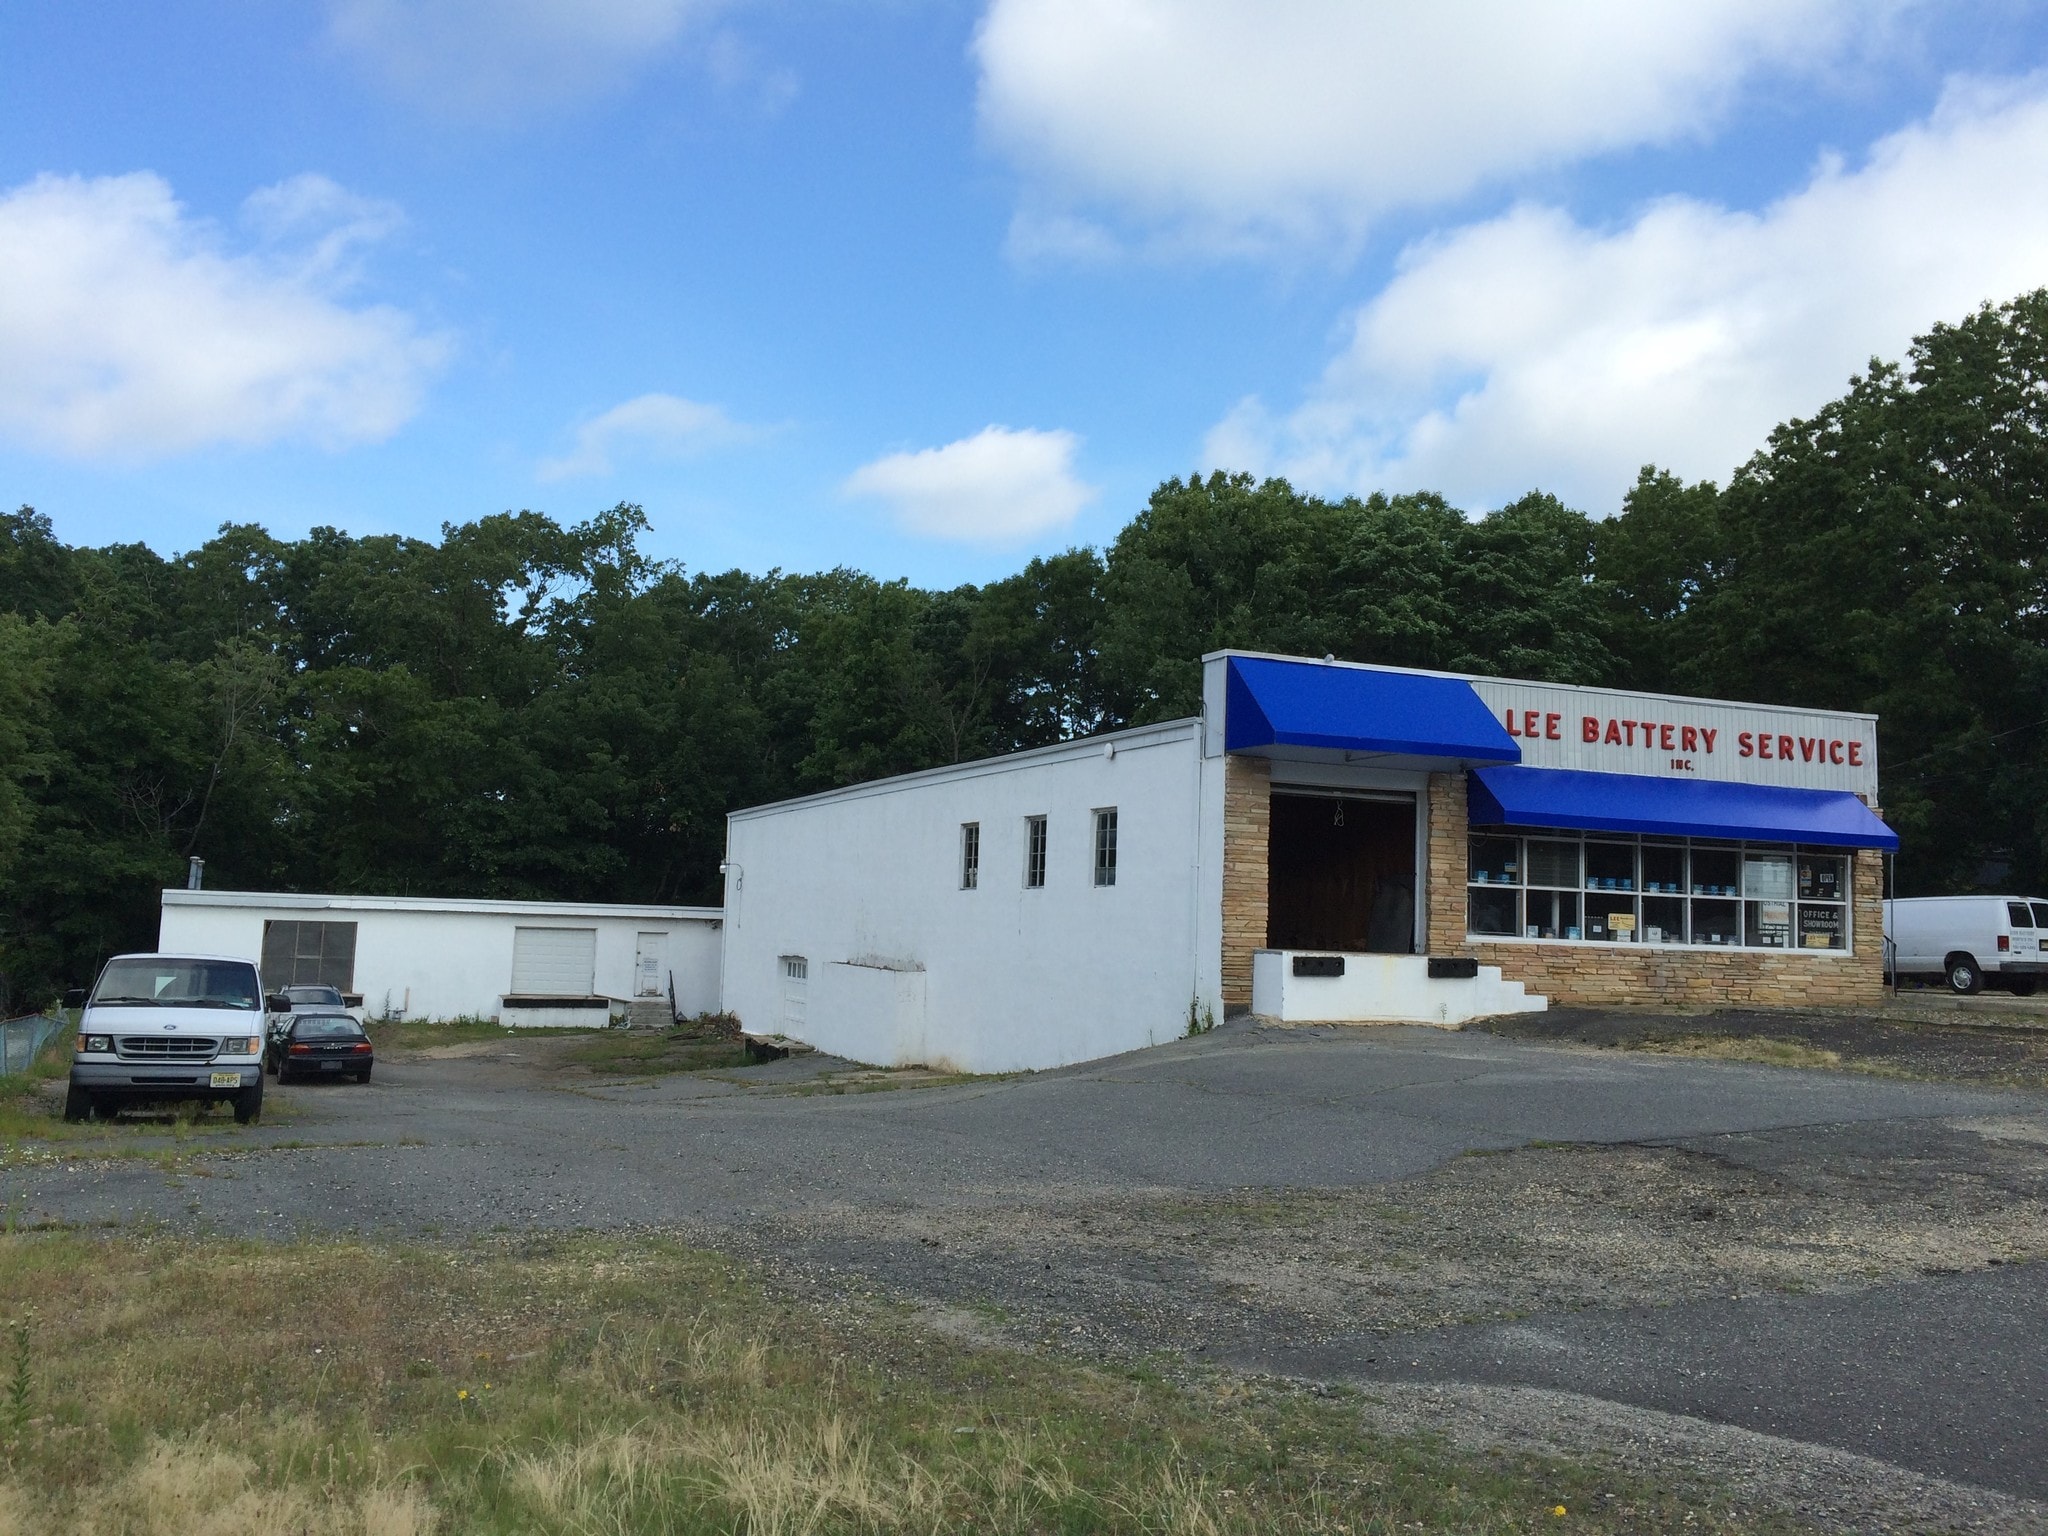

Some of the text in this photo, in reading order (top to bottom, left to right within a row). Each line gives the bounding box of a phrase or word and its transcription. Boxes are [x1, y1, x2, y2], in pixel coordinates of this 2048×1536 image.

[1506, 708, 1864, 767] LEE BATTERY SERVICE
[1670, 759, 1695, 772] INC.
[1803, 910, 1830, 919] OFFICE
[1803, 920, 1839, 929] SHOWROOM
